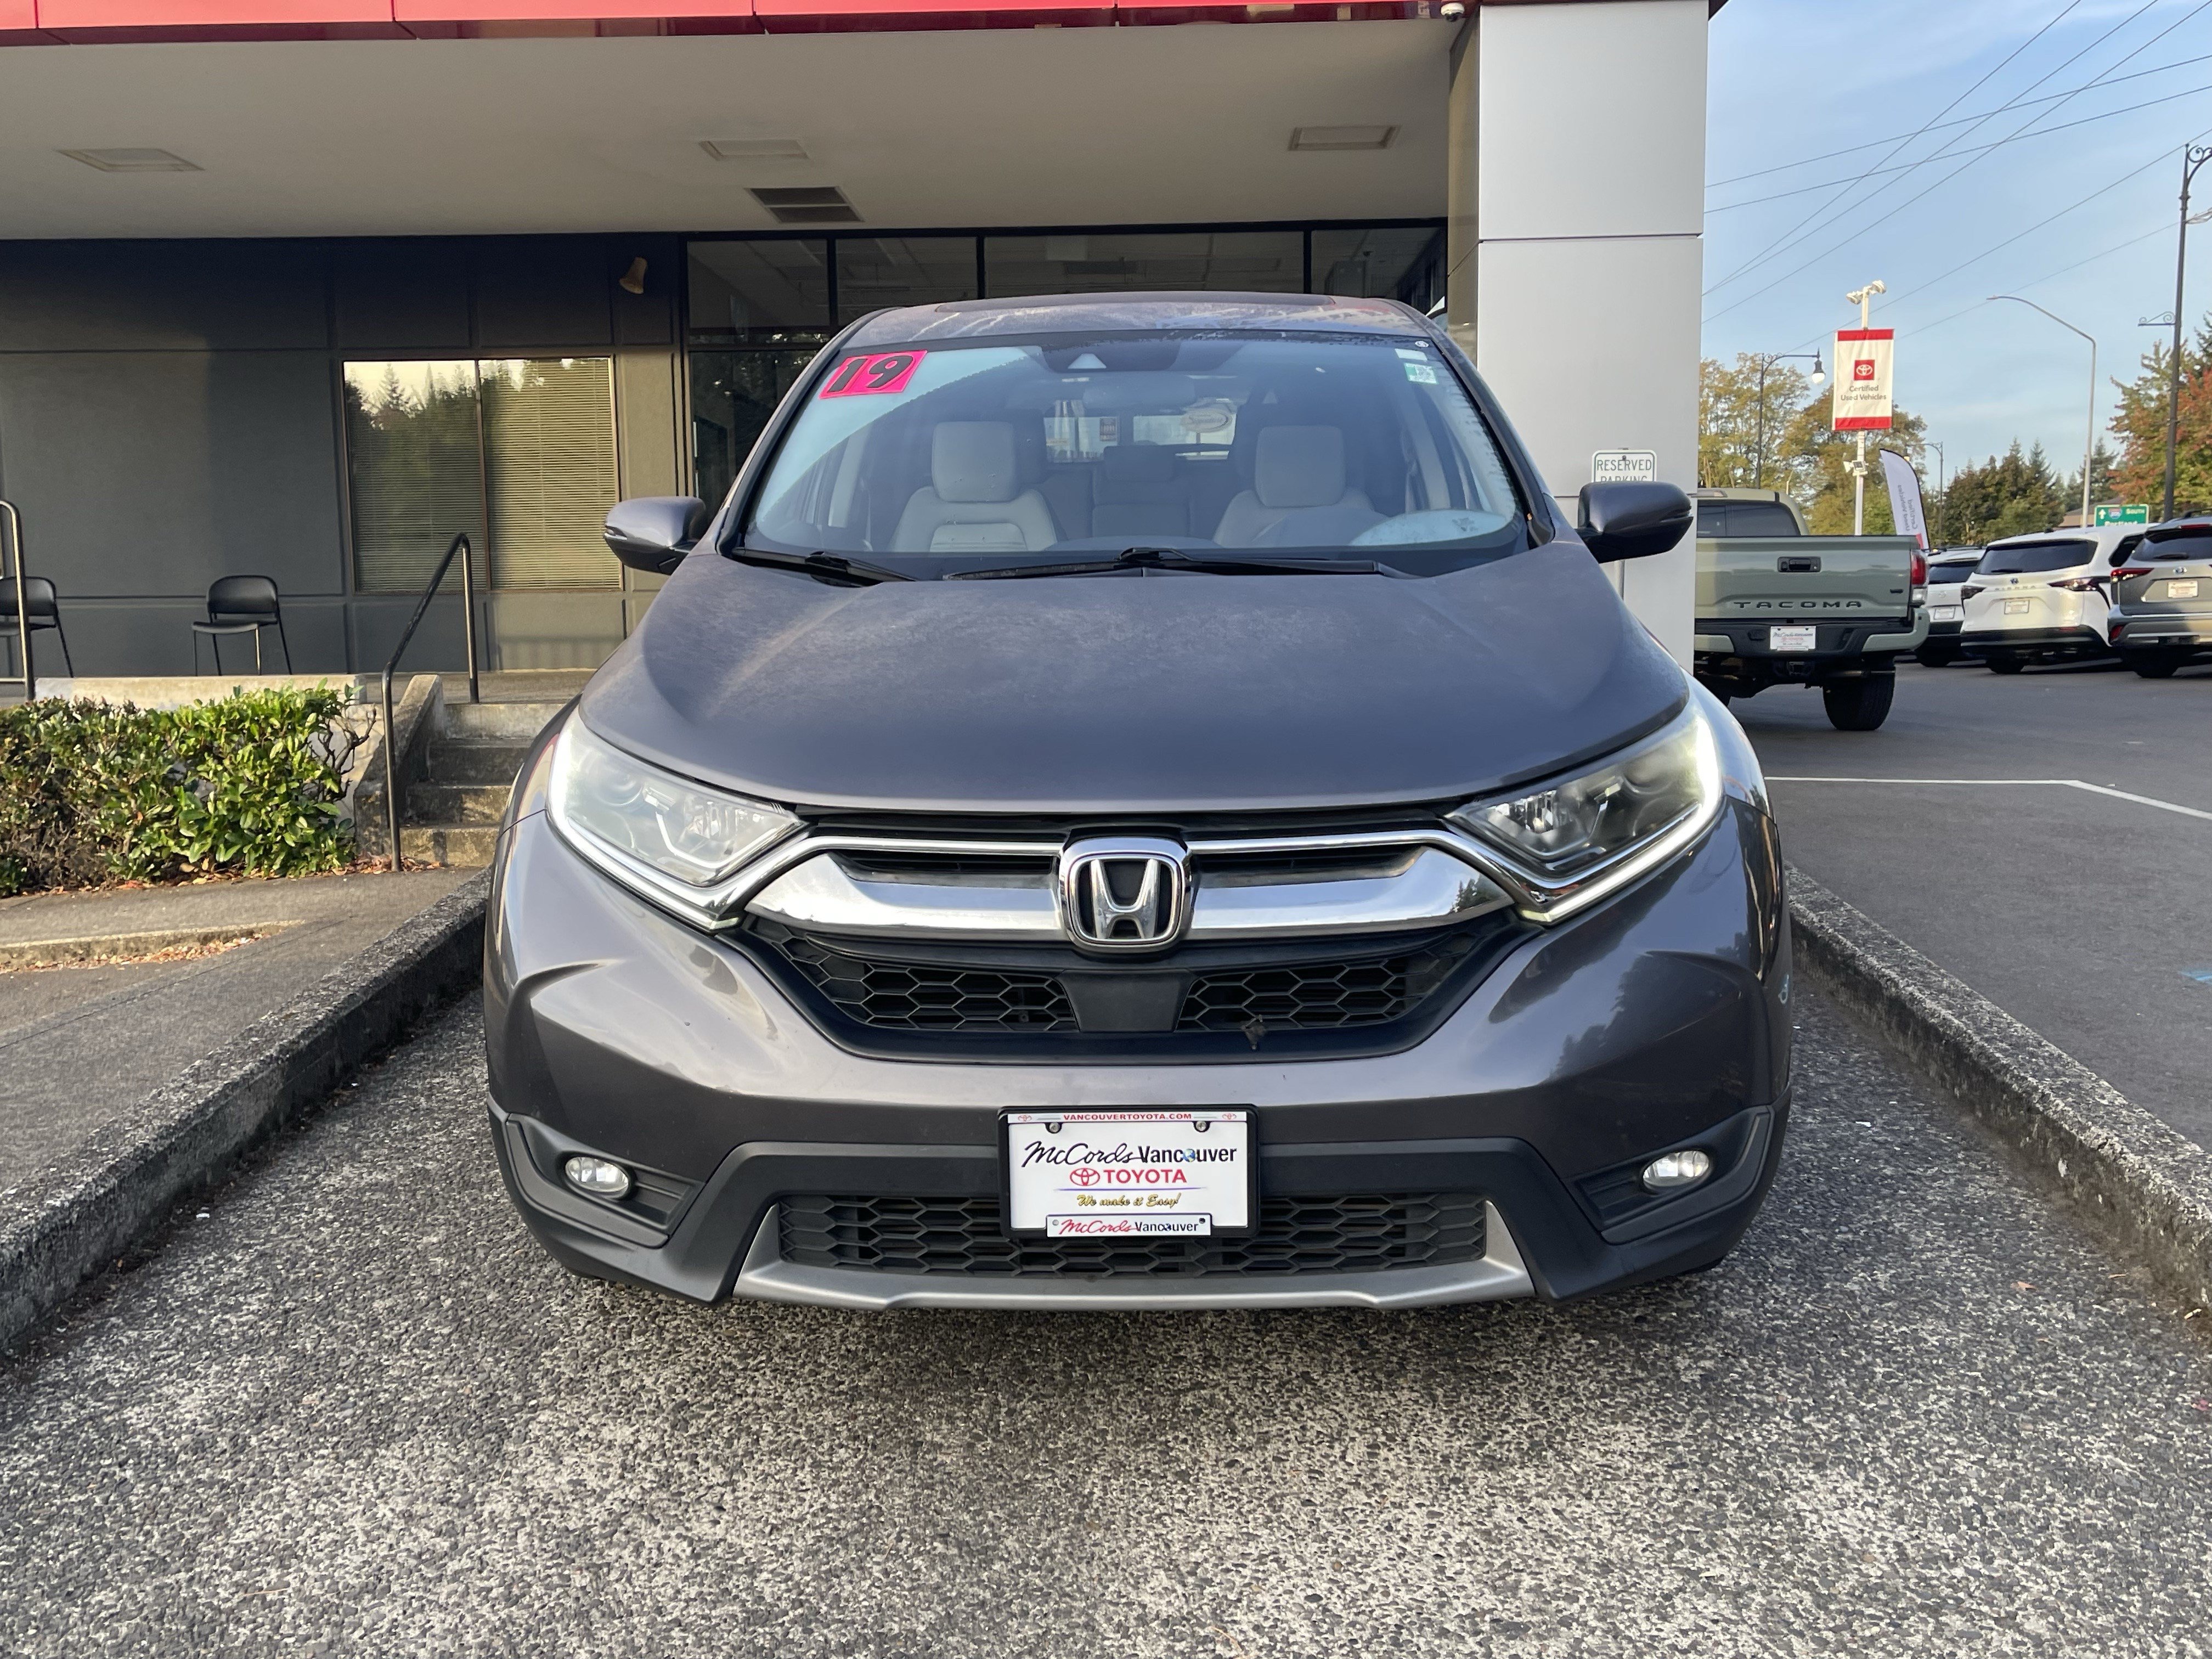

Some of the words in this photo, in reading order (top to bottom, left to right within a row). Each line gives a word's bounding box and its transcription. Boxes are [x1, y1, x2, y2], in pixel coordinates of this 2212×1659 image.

[827, 354, 914, 393] 19
[1596, 459, 1652, 471] RESERVED
[1733, 601, 1863, 609] TACOMA
[1103, 1169, 1187, 1184] TOYOTA
[1076, 1194, 1097, 1207] We
[1099, 1195, 1130, 1207] make
[1133, 1194, 1143, 1206] it
[1146, 1192, 1182, 1208] Easy!
